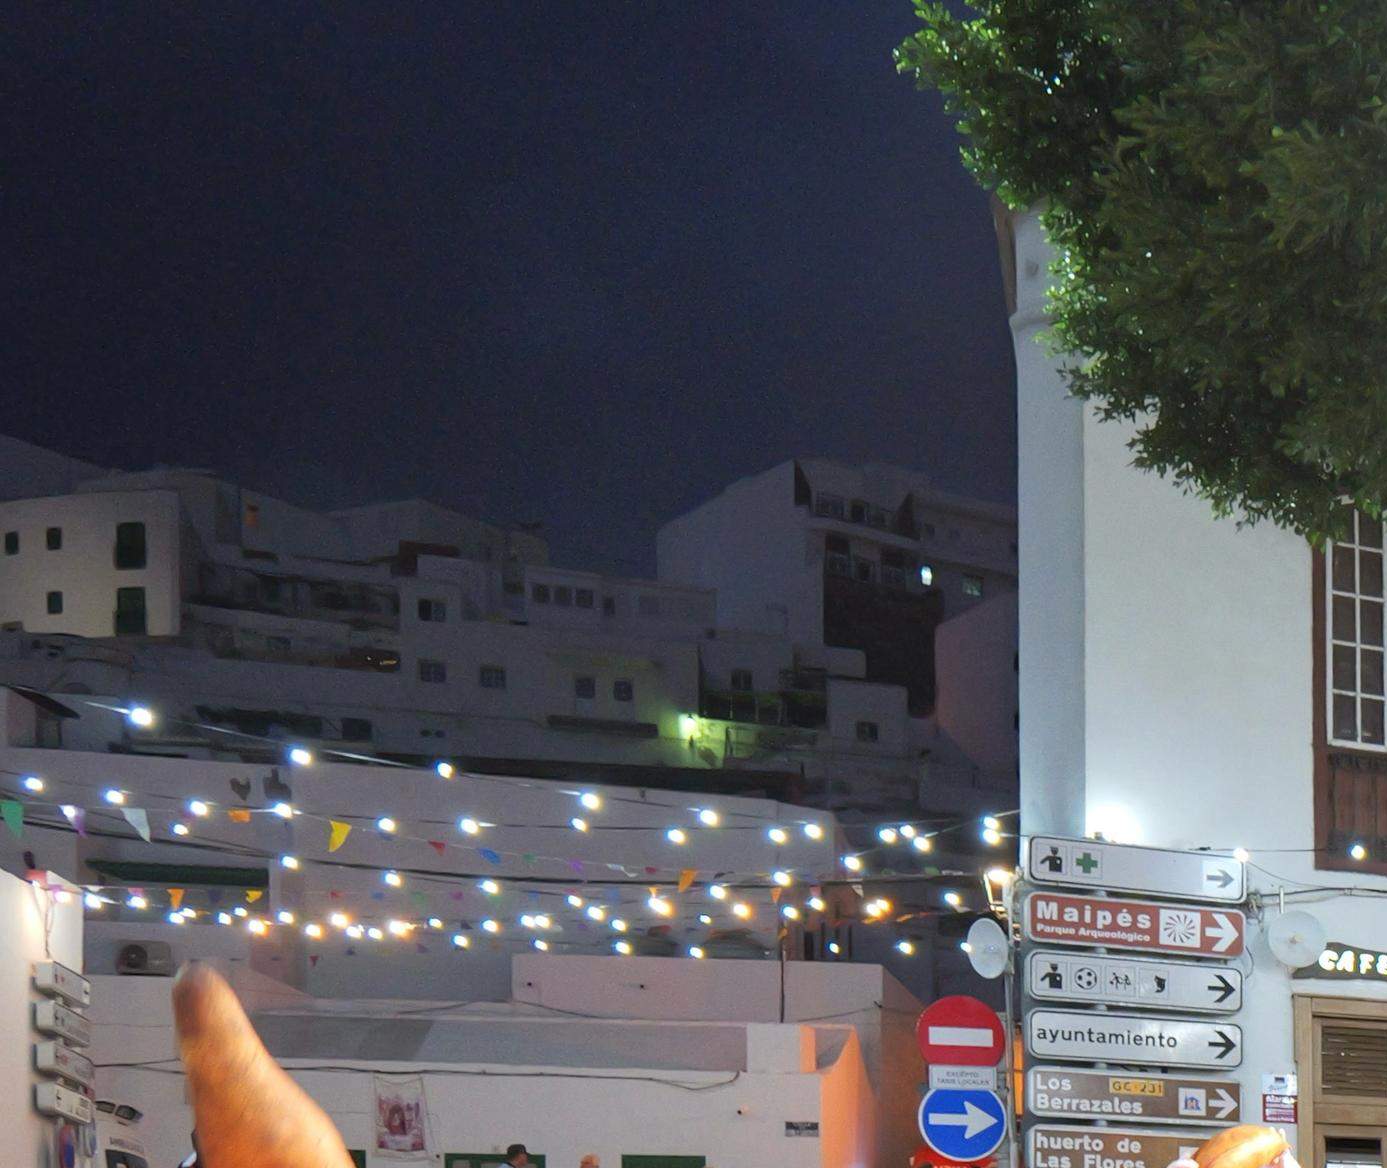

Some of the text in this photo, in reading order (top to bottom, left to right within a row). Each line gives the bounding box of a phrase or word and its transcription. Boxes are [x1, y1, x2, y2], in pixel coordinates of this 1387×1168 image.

[1036, 900, 1152, 930] Maipés
[1036, 923, 1076, 937] Parque
[1036, 1027, 1178, 1049] ayuntamiento
[1036, 1073, 1072, 1091] Los
[1036, 1093, 1143, 1115] Berrazales
[1036, 1132, 1142, 1154] huerto de
